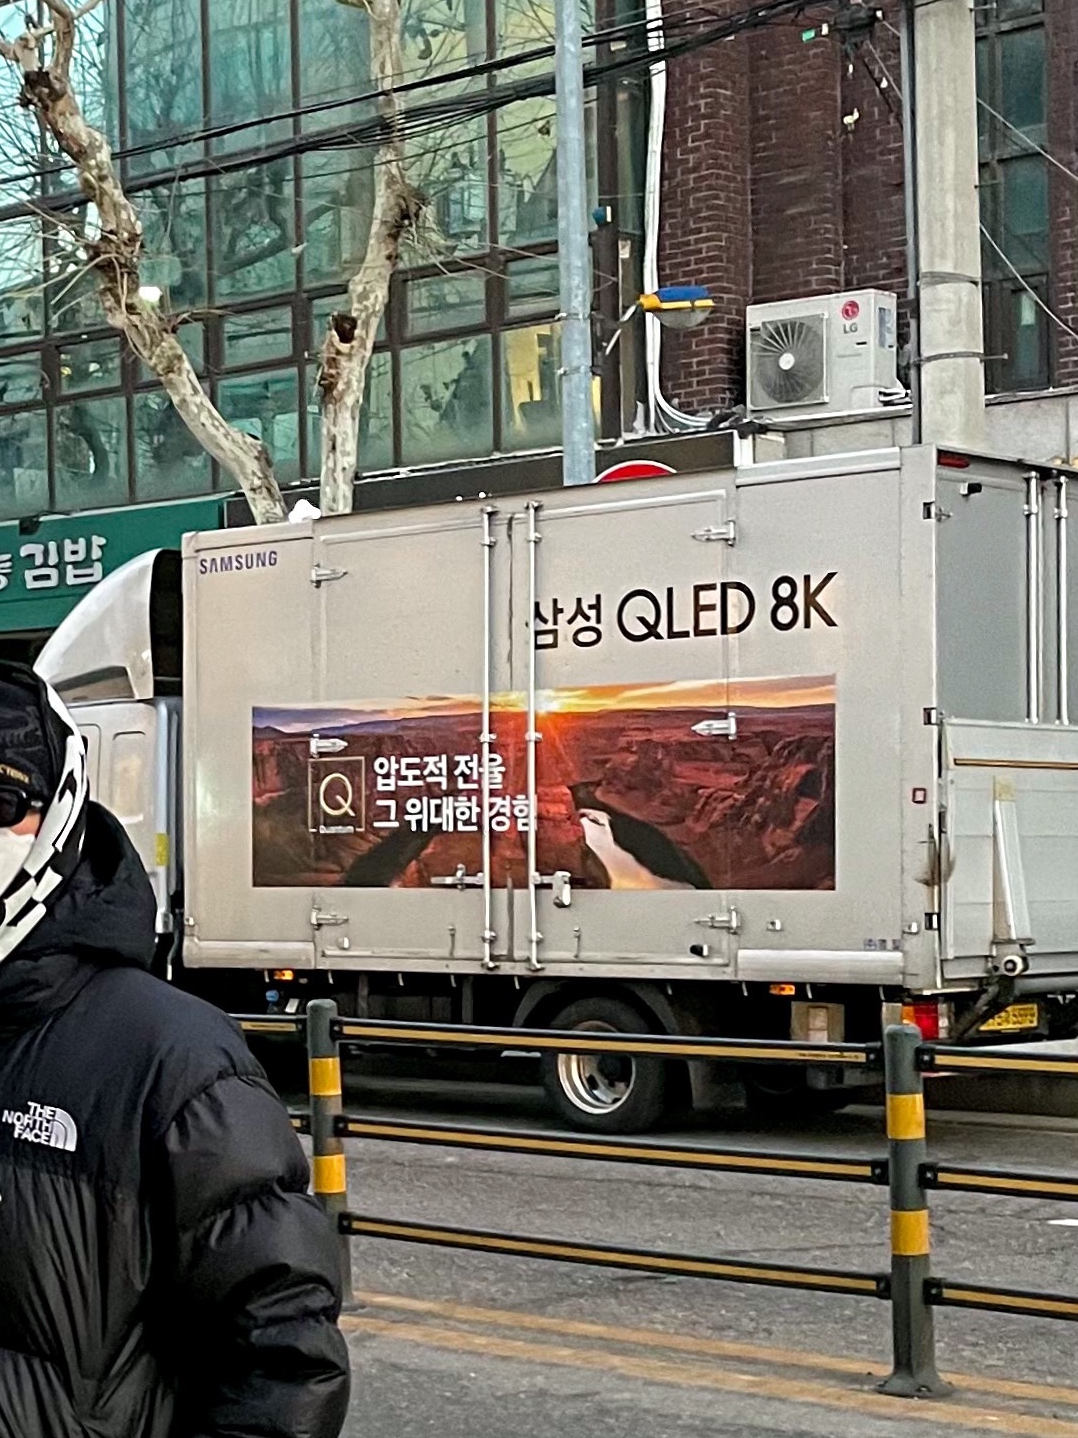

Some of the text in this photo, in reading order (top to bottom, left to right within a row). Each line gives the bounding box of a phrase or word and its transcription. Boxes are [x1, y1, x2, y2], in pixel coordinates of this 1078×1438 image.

[843, 322, 859, 334] LG
[20, 535, 108, 590] 김밥
[199, 550, 278, 575] SAMSUNG
[533, 571, 839, 650] 삼성 QLED 8K
[373, 753, 507, 792] 압도적 전율
[319, 772, 357, 818] Q
[373, 794, 538, 833] 그 위대한 경험
[1, 1109, 53, 1134] NORTH
[27, 1101, 56, 1121] THE
[13, 1126, 52, 1147] FACE
